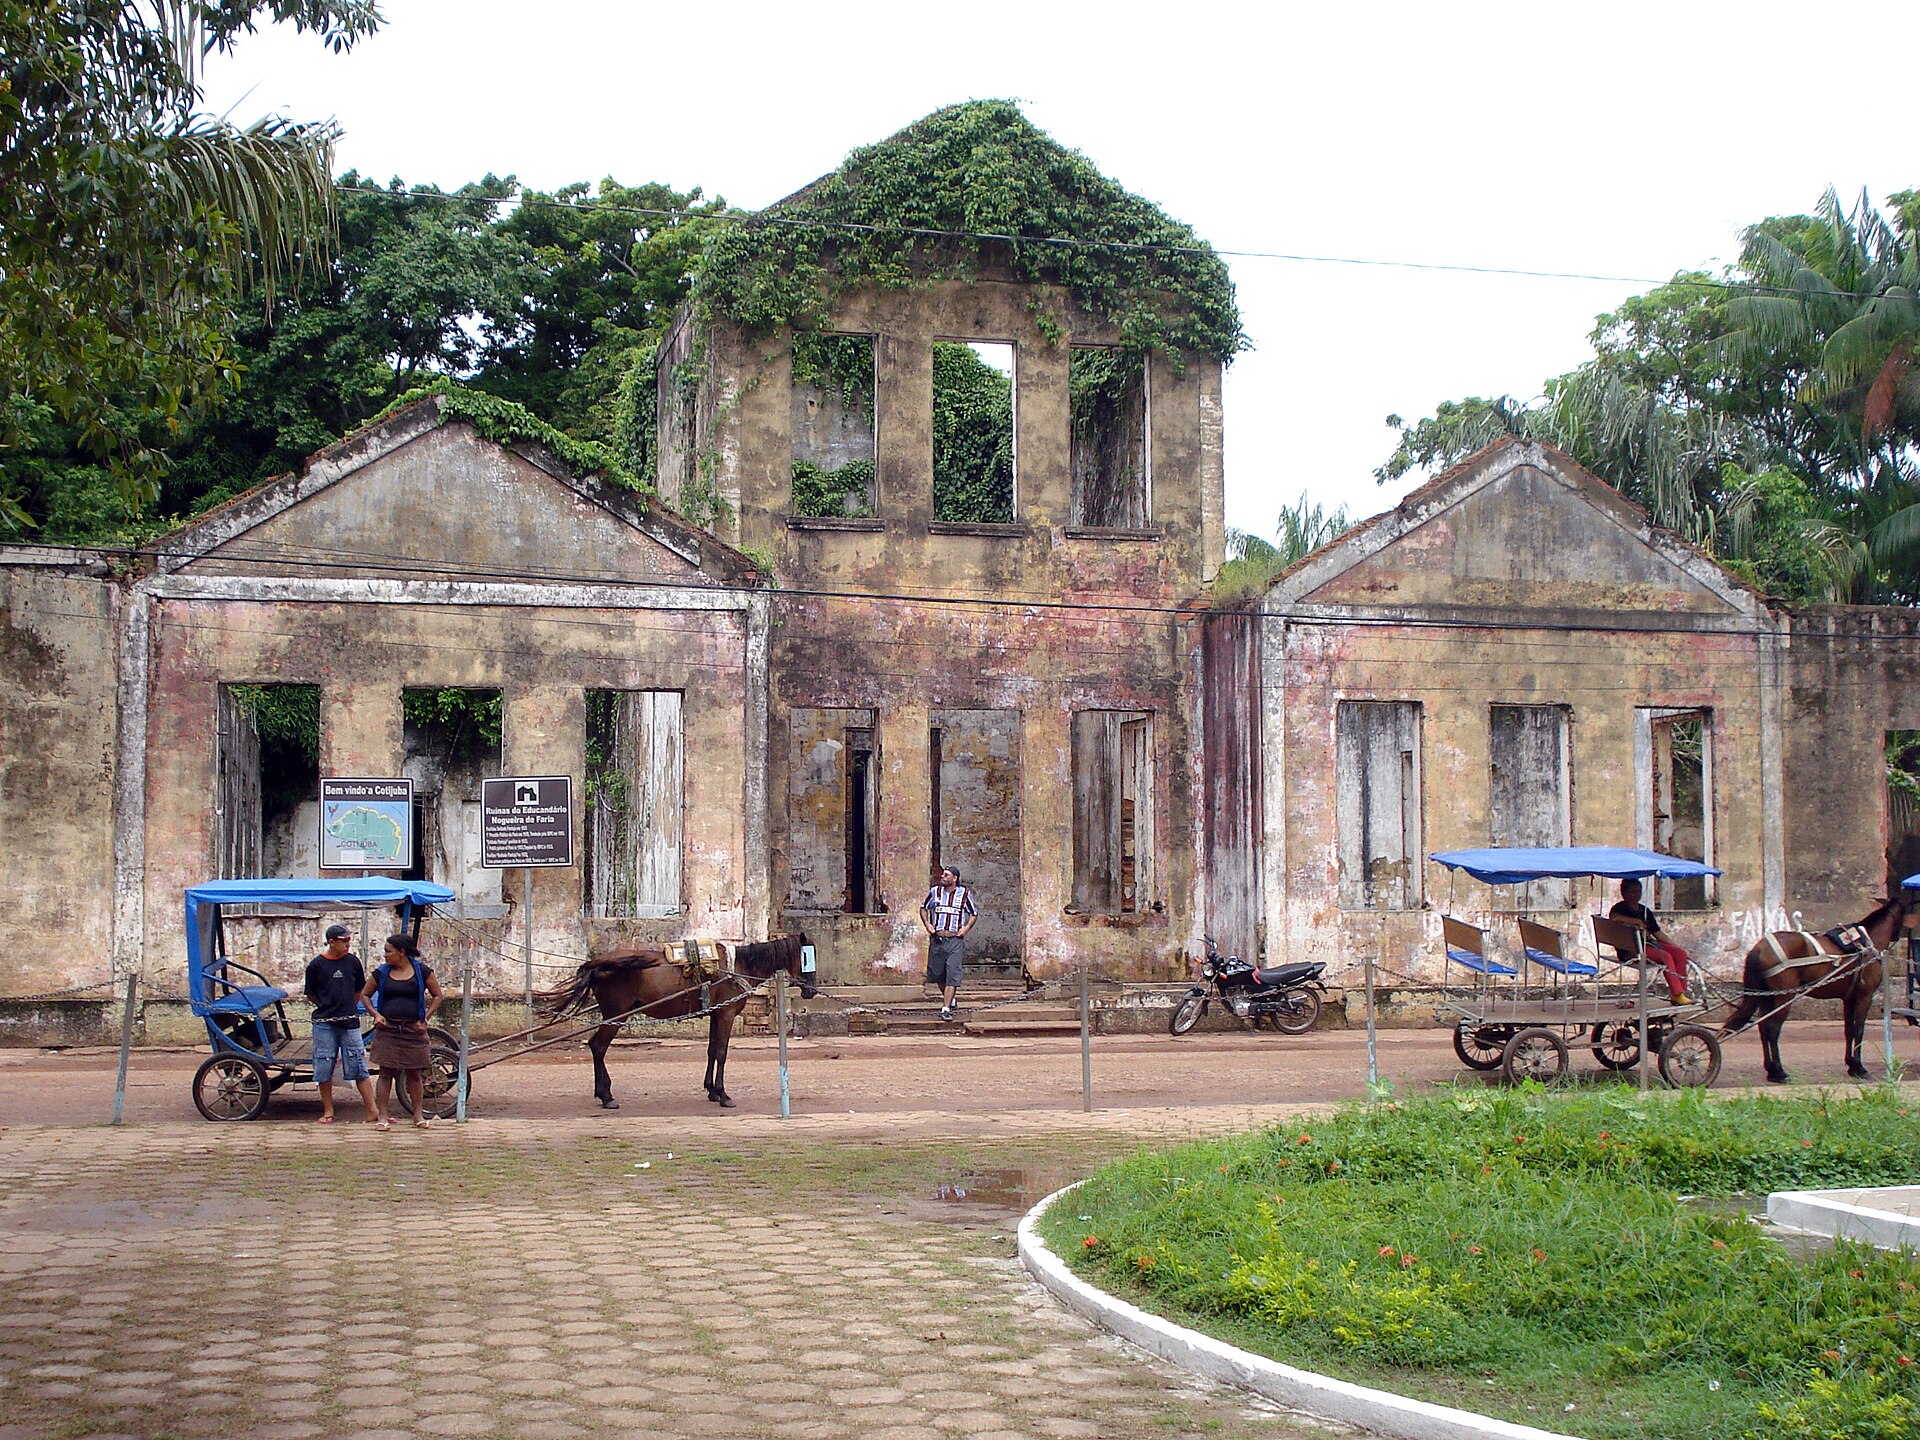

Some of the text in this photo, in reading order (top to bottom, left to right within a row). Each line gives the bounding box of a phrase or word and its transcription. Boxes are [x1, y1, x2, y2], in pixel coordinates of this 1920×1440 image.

[325, 785, 343, 795] Bem
[345, 785, 365, 795] vindo
[375, 785, 407, 797] Cotijuba
[511, 806, 521, 814] do
[491, 815, 555, 825] Nogueira de Faria
